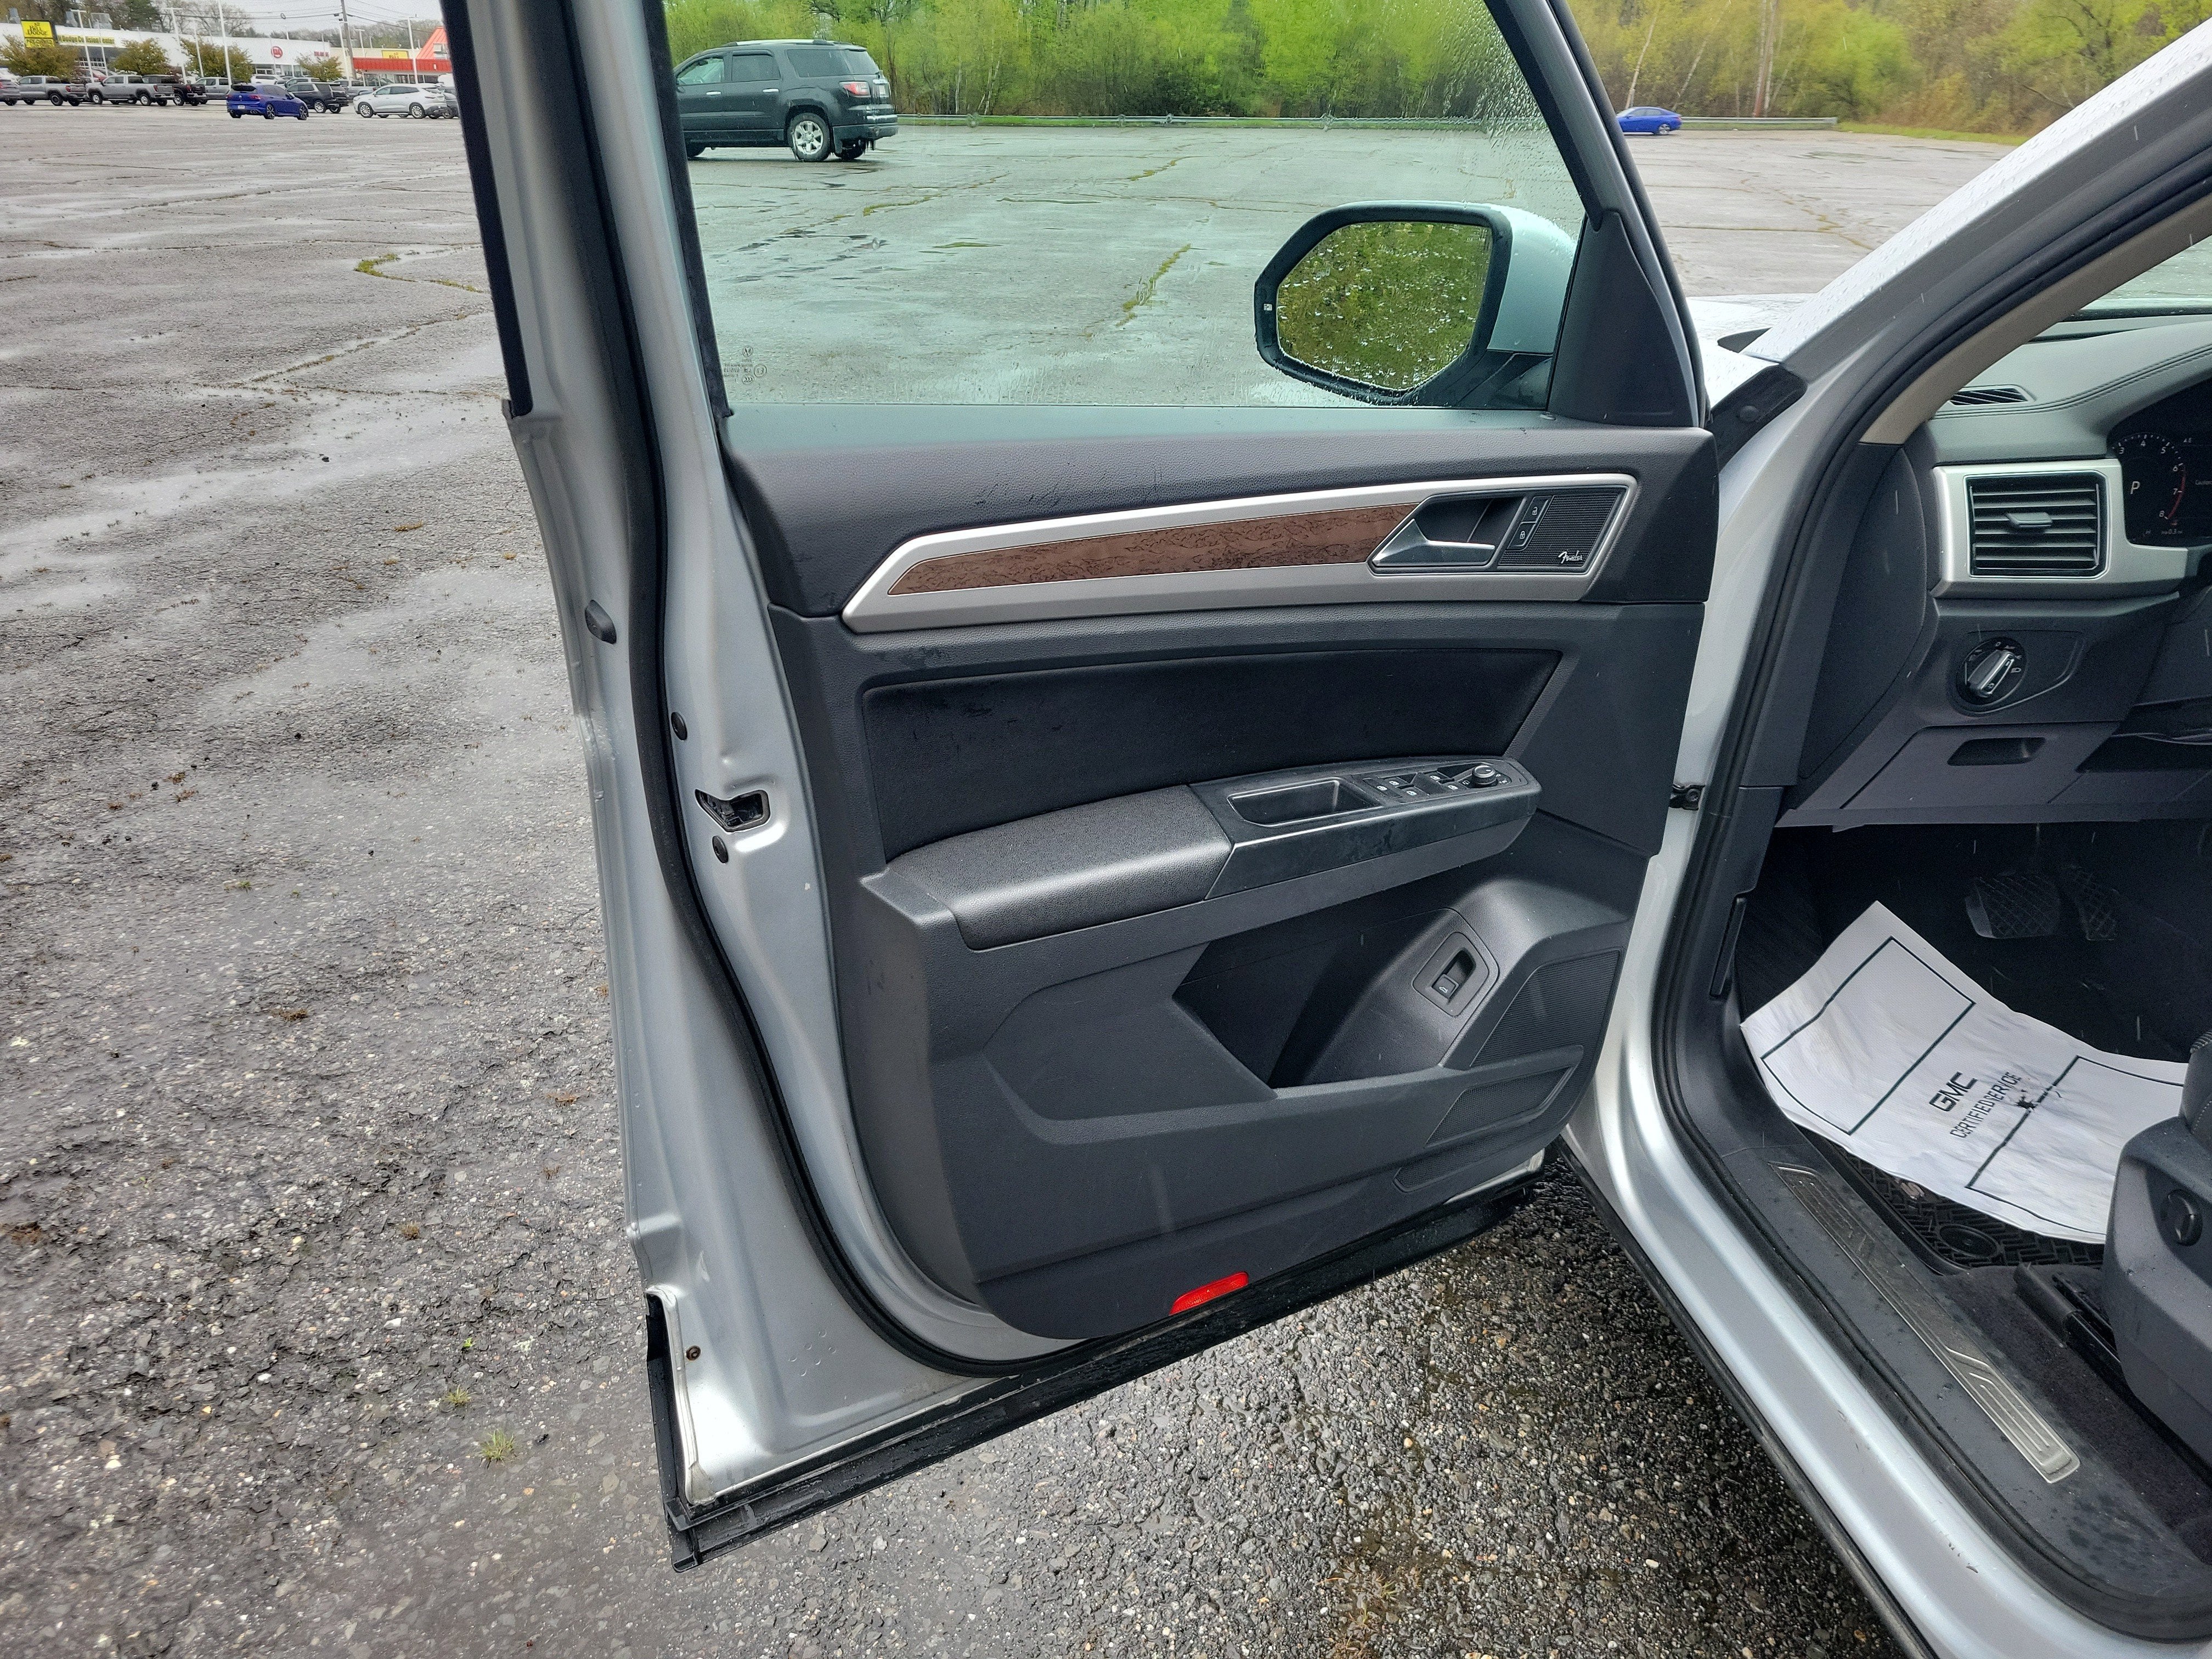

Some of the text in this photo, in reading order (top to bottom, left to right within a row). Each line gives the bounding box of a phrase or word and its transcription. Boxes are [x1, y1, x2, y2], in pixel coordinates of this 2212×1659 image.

[2130, 481, 2140, 494] P
[1558, 550, 1583, 564] Fender
[1929, 1071, 1978, 1111] GMC
